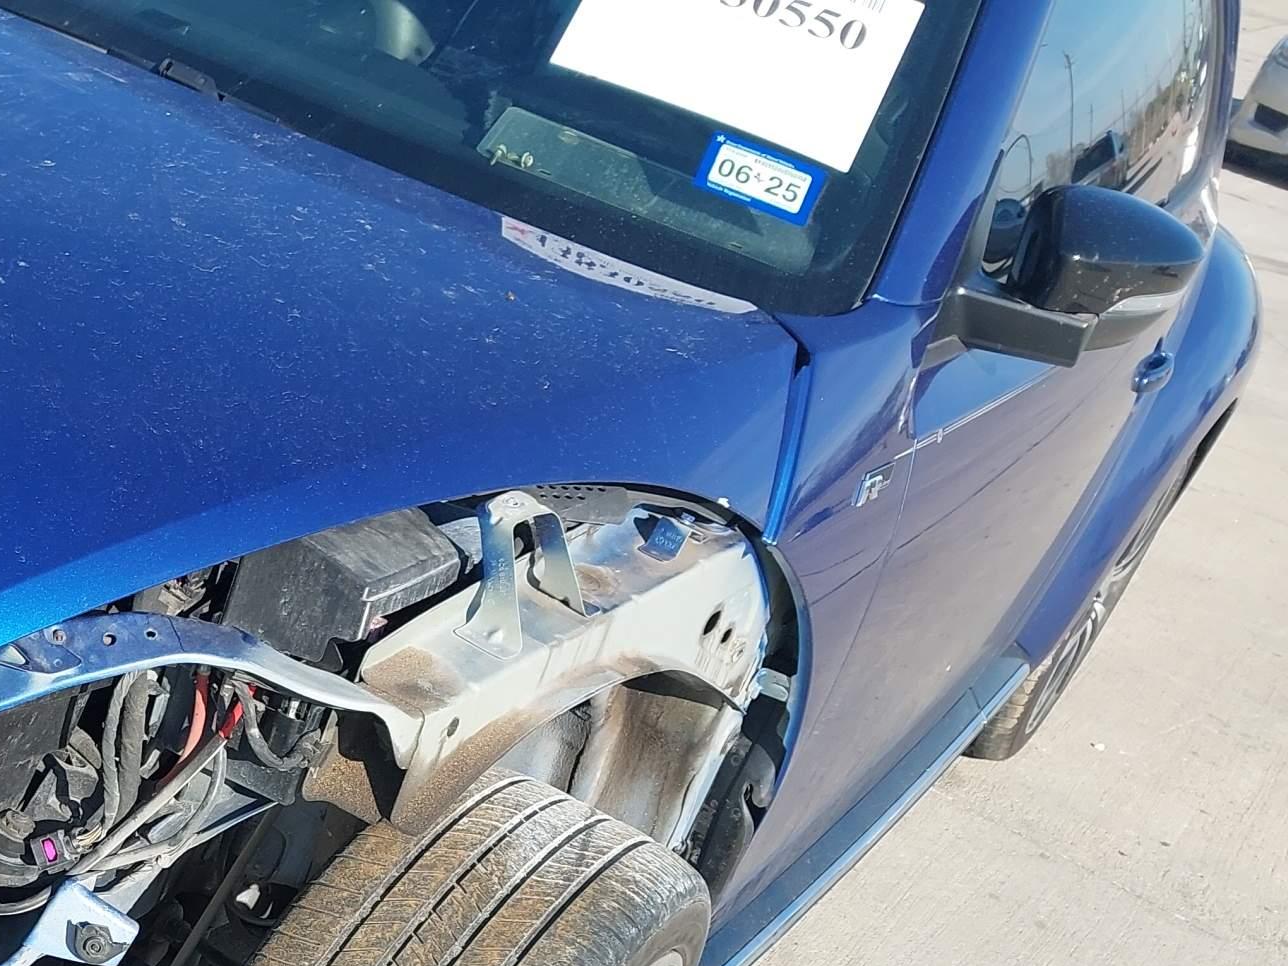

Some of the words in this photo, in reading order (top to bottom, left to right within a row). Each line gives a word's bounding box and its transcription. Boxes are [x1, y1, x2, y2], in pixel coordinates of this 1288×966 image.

[720, 0, 867, 50] 0550
[717, 158, 753, 184] 06
[763, 176, 802, 203] 25
